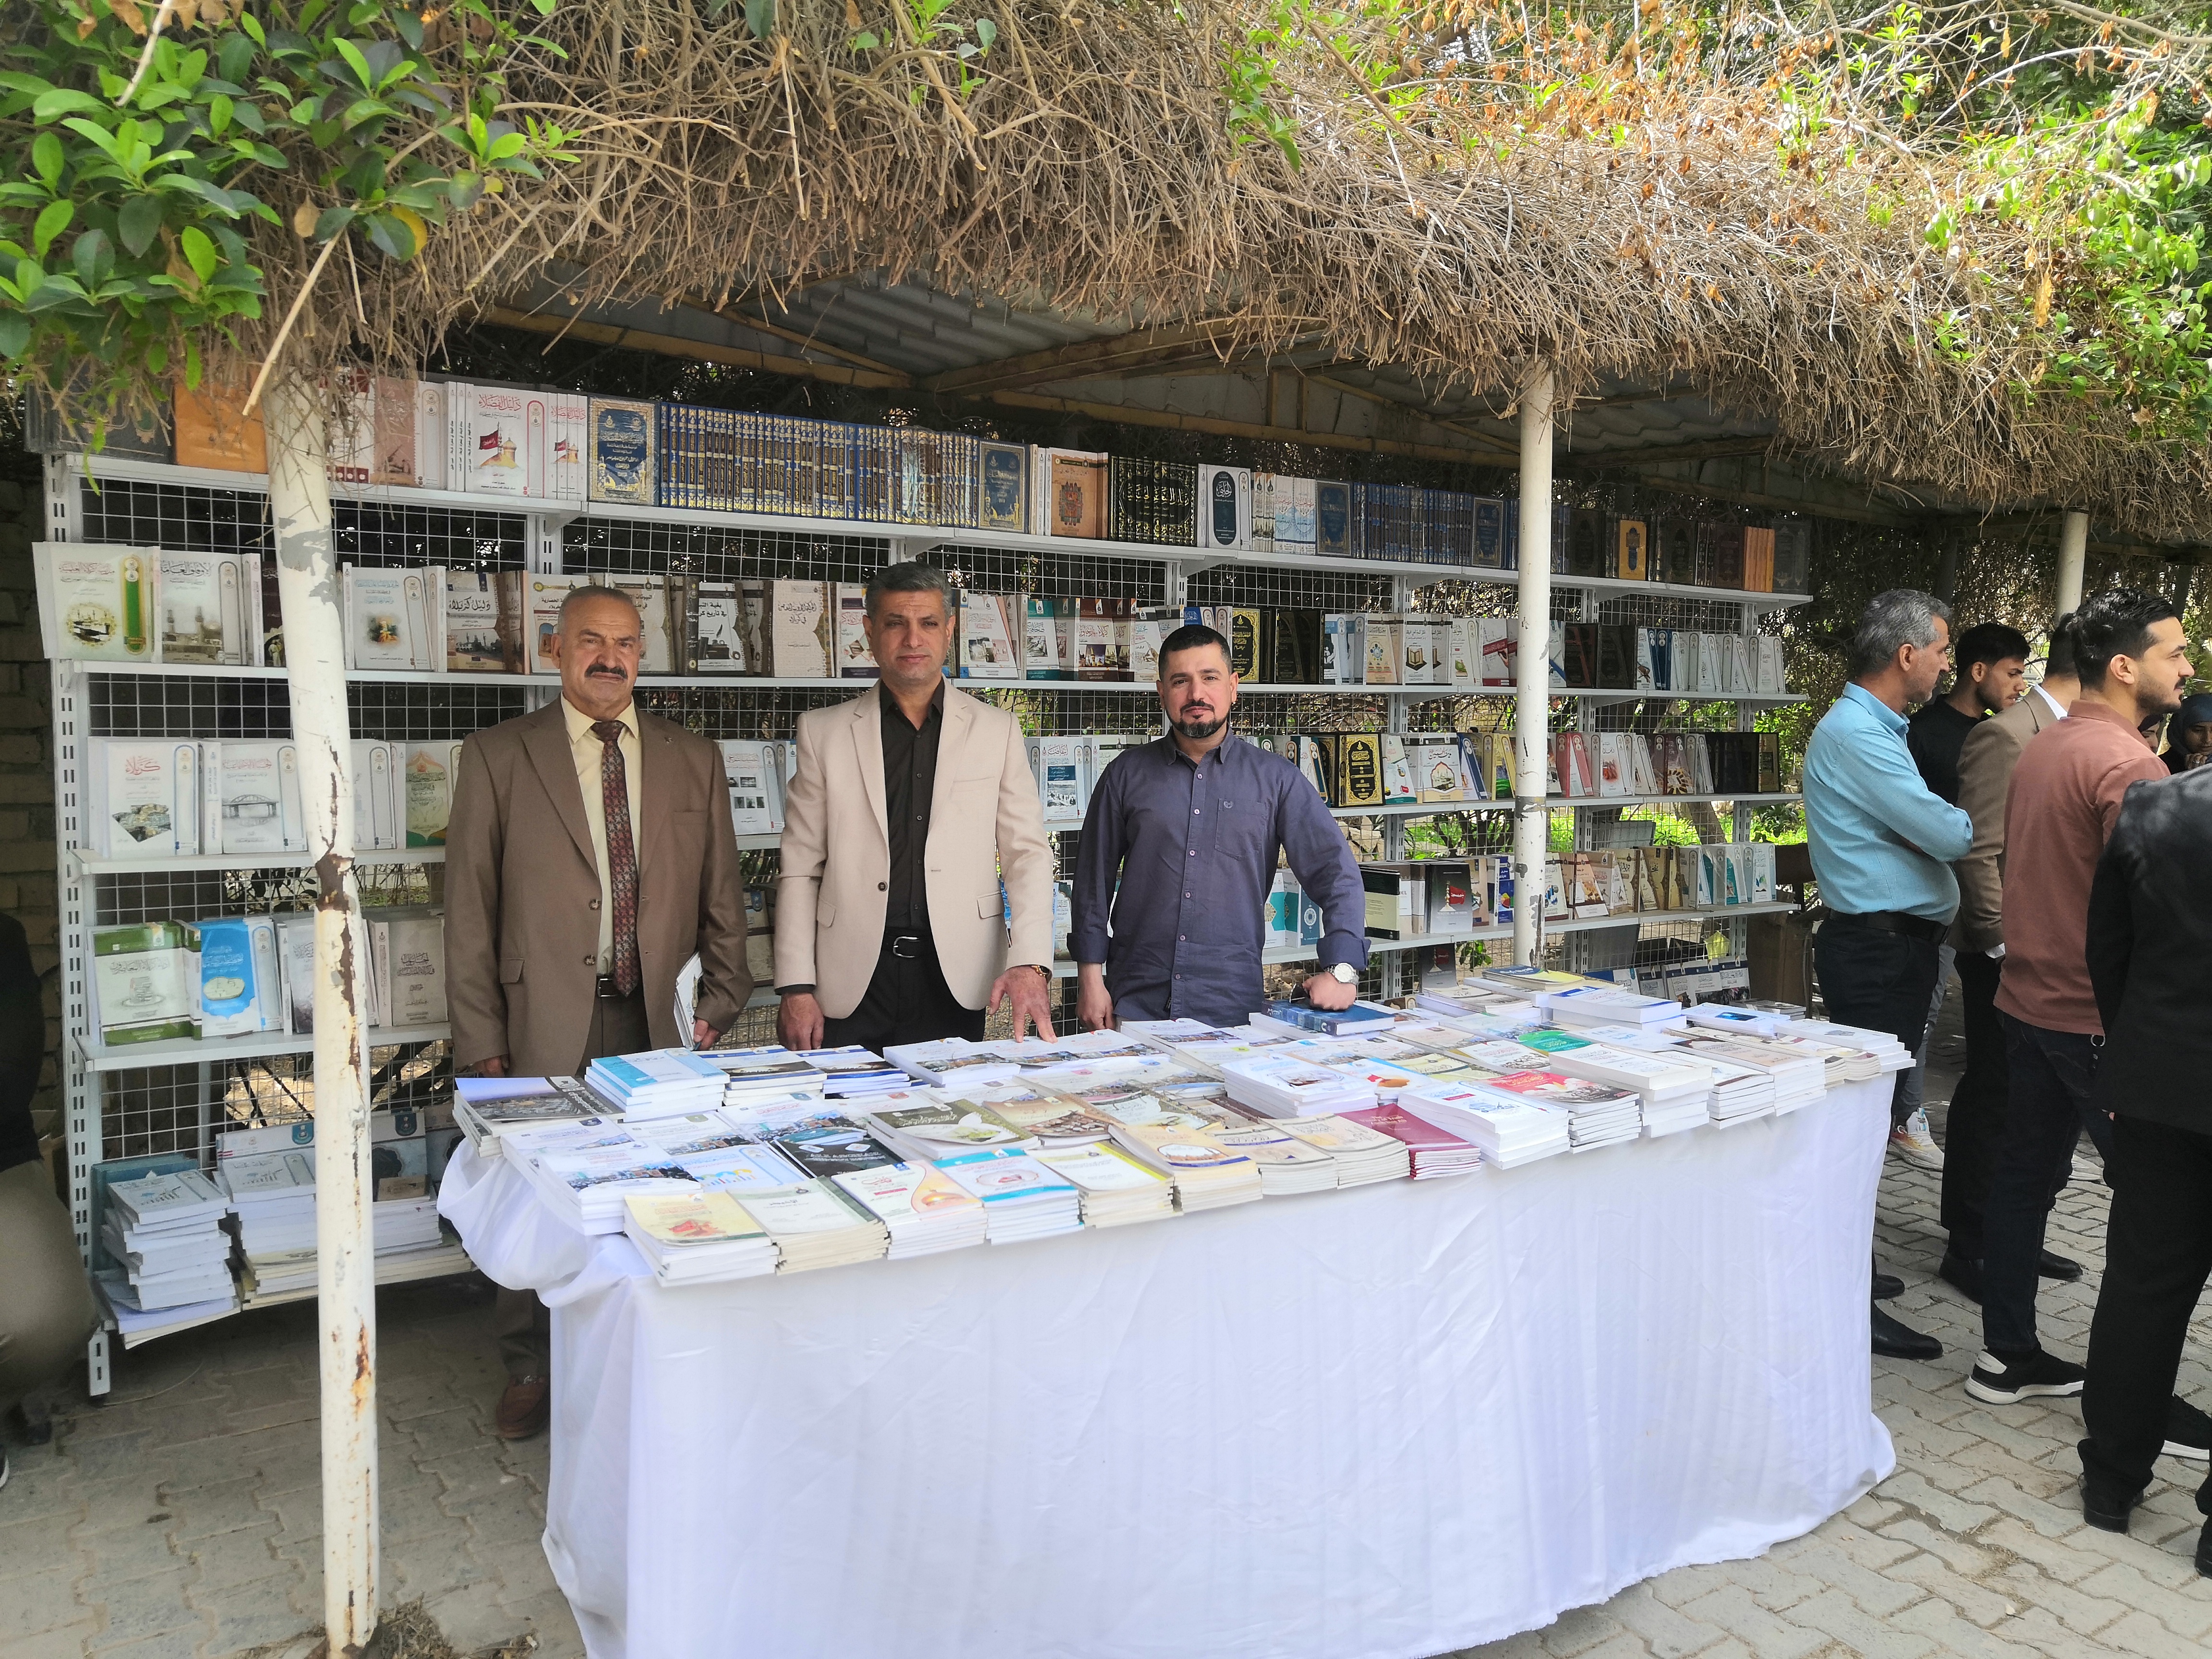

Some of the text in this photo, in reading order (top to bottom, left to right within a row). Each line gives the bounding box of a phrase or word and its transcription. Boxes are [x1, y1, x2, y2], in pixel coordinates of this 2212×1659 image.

[449, 596, 491, 611] دليل كربلاء
[125, 756, 161, 776] كربلاء
